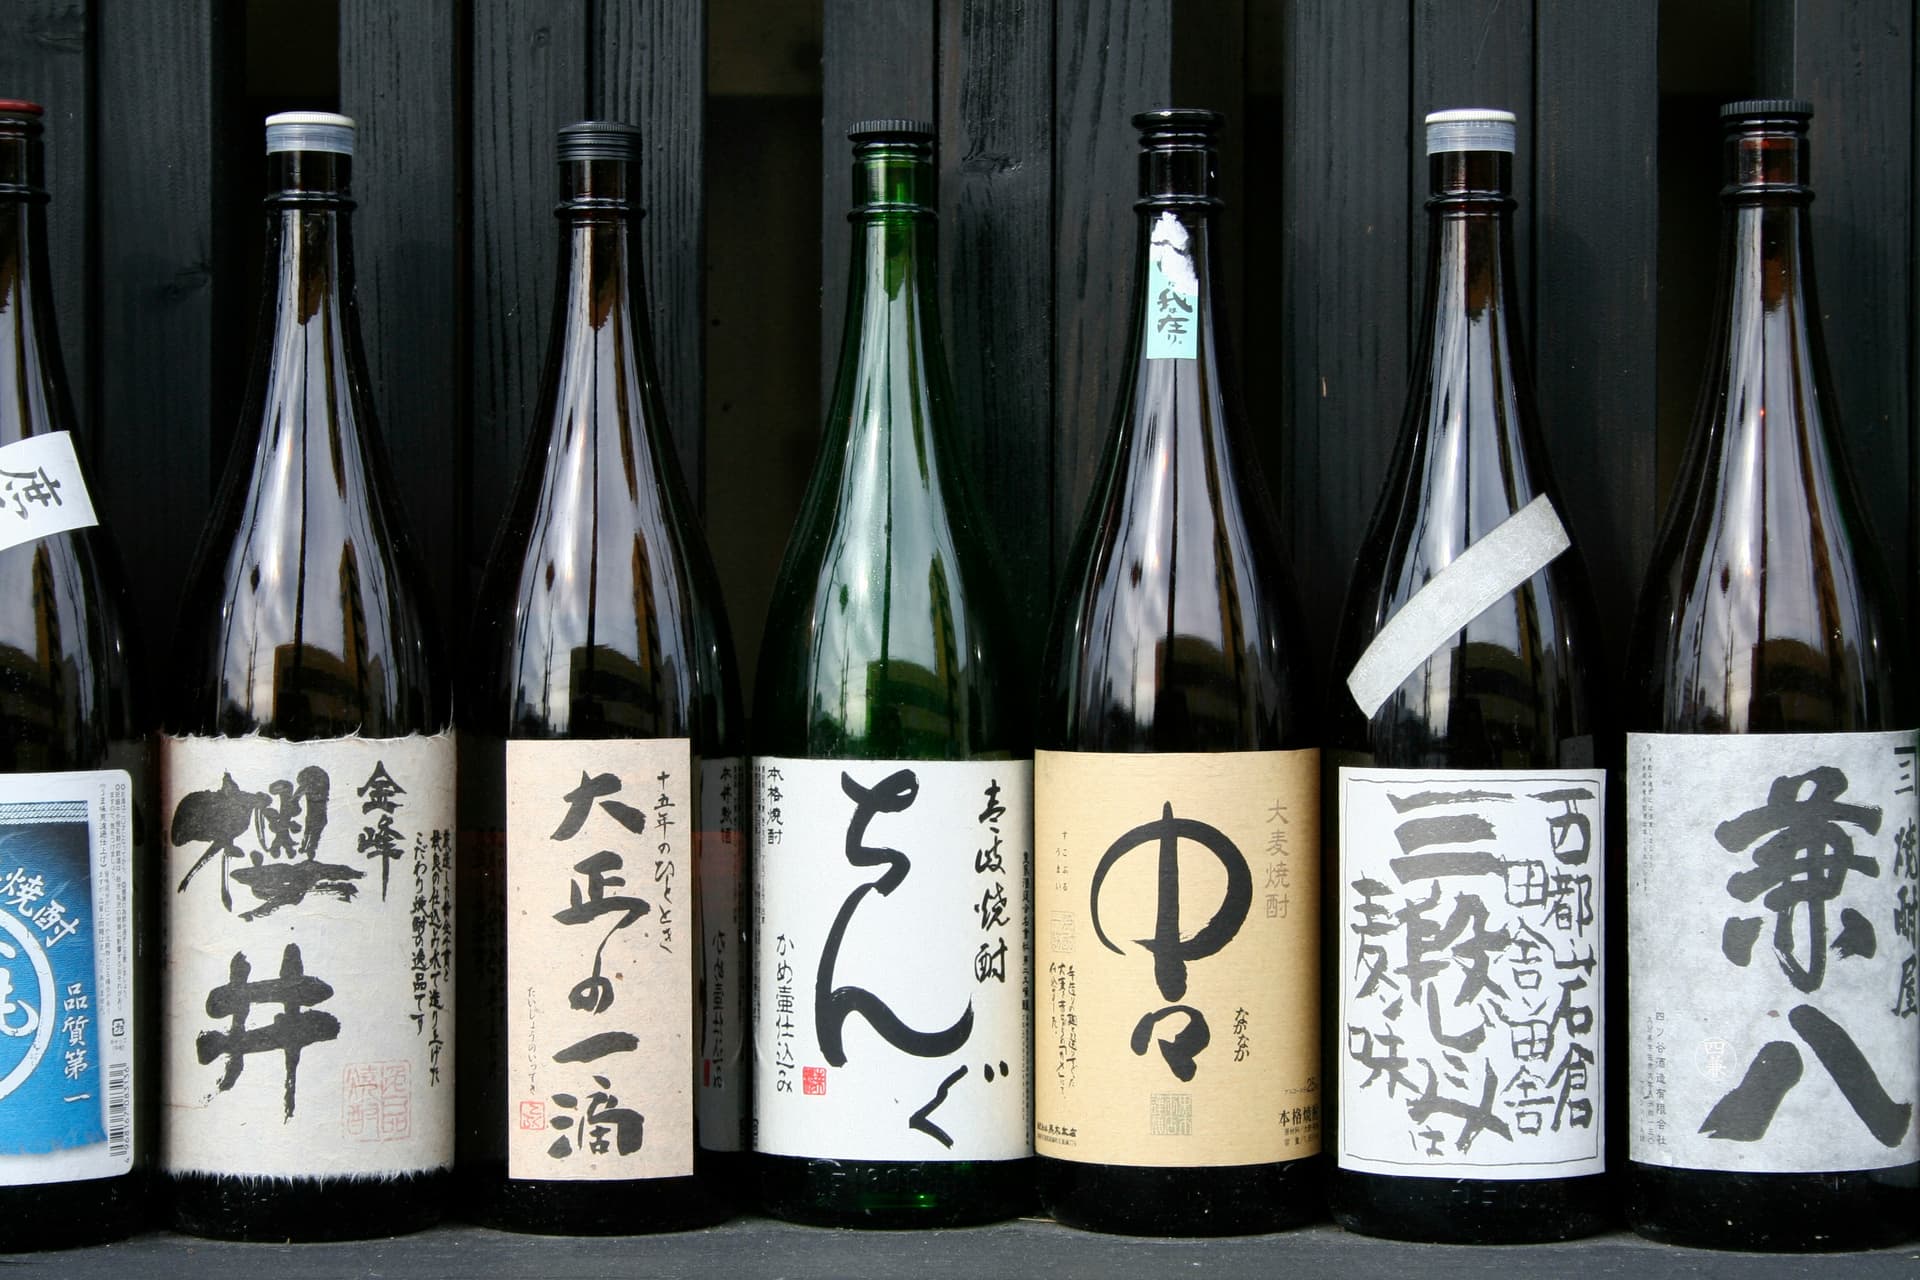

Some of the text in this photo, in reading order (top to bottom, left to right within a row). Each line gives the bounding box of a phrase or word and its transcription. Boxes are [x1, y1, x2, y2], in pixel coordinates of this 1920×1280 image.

[357, 760, 406, 902] 金峰
[654, 771, 676, 954] 十五年のひととき
[767, 767, 784, 845] 本格焼酎
[1265, 799, 1290, 920] 大麦焼酎
[0, 867, 80, 948] 焼酎
[549, 770, 651, 1159] 大正の一滴
[815, 769, 1009, 1150] ちんぐ
[1090, 801, 1253, 1083] 中々
[1698, 766, 1912, 1148] 兼八
[61, 983, 91, 1103] 品質第一
[1233, 1007, 1250, 1063] なかなか
